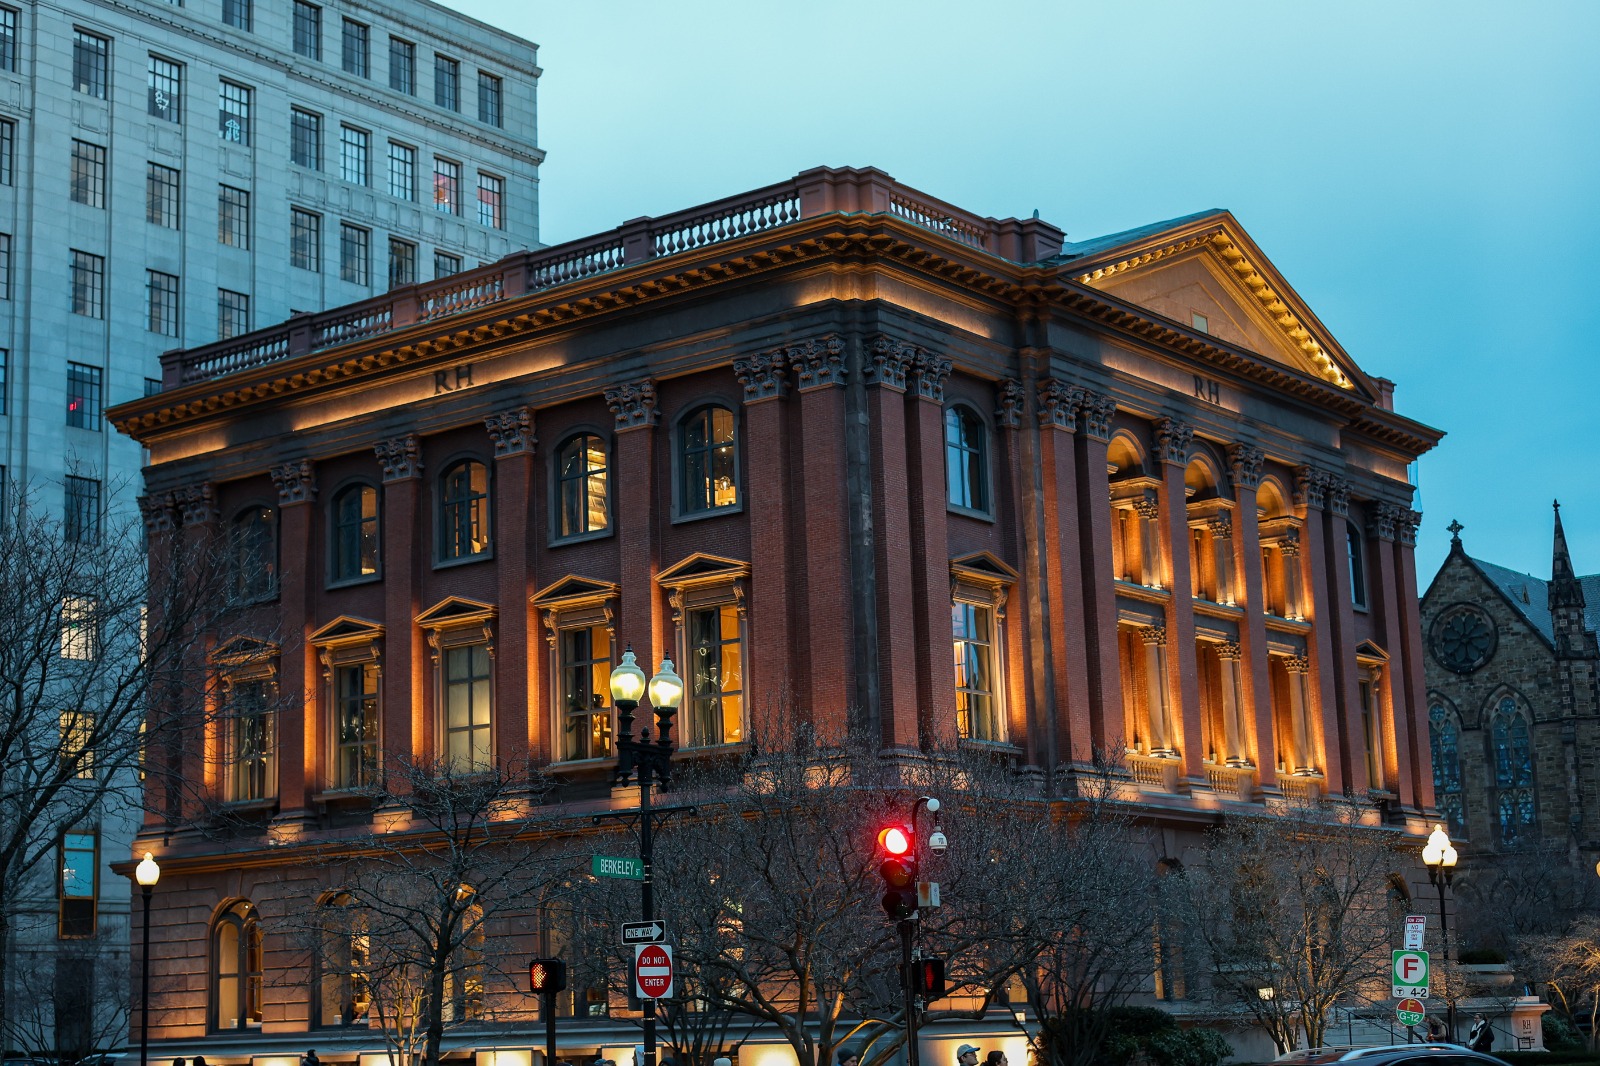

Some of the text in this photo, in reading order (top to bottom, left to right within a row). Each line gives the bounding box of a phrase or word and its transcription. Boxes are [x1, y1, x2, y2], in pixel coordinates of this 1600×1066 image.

[434, 364, 474, 395] RH
[1193, 375, 1220, 405] RH
[601, 859, 634, 875] BERKELEY
[626, 927, 653, 937] ONE WAY
[1403, 958, 1418, 978] F
[1411, 988, 1426, 997] 4-2
[1406, 1000, 1415, 1011] F
[1399, 1012, 1420, 1022] G-12
[1522, 1020, 1531, 1029] RH
